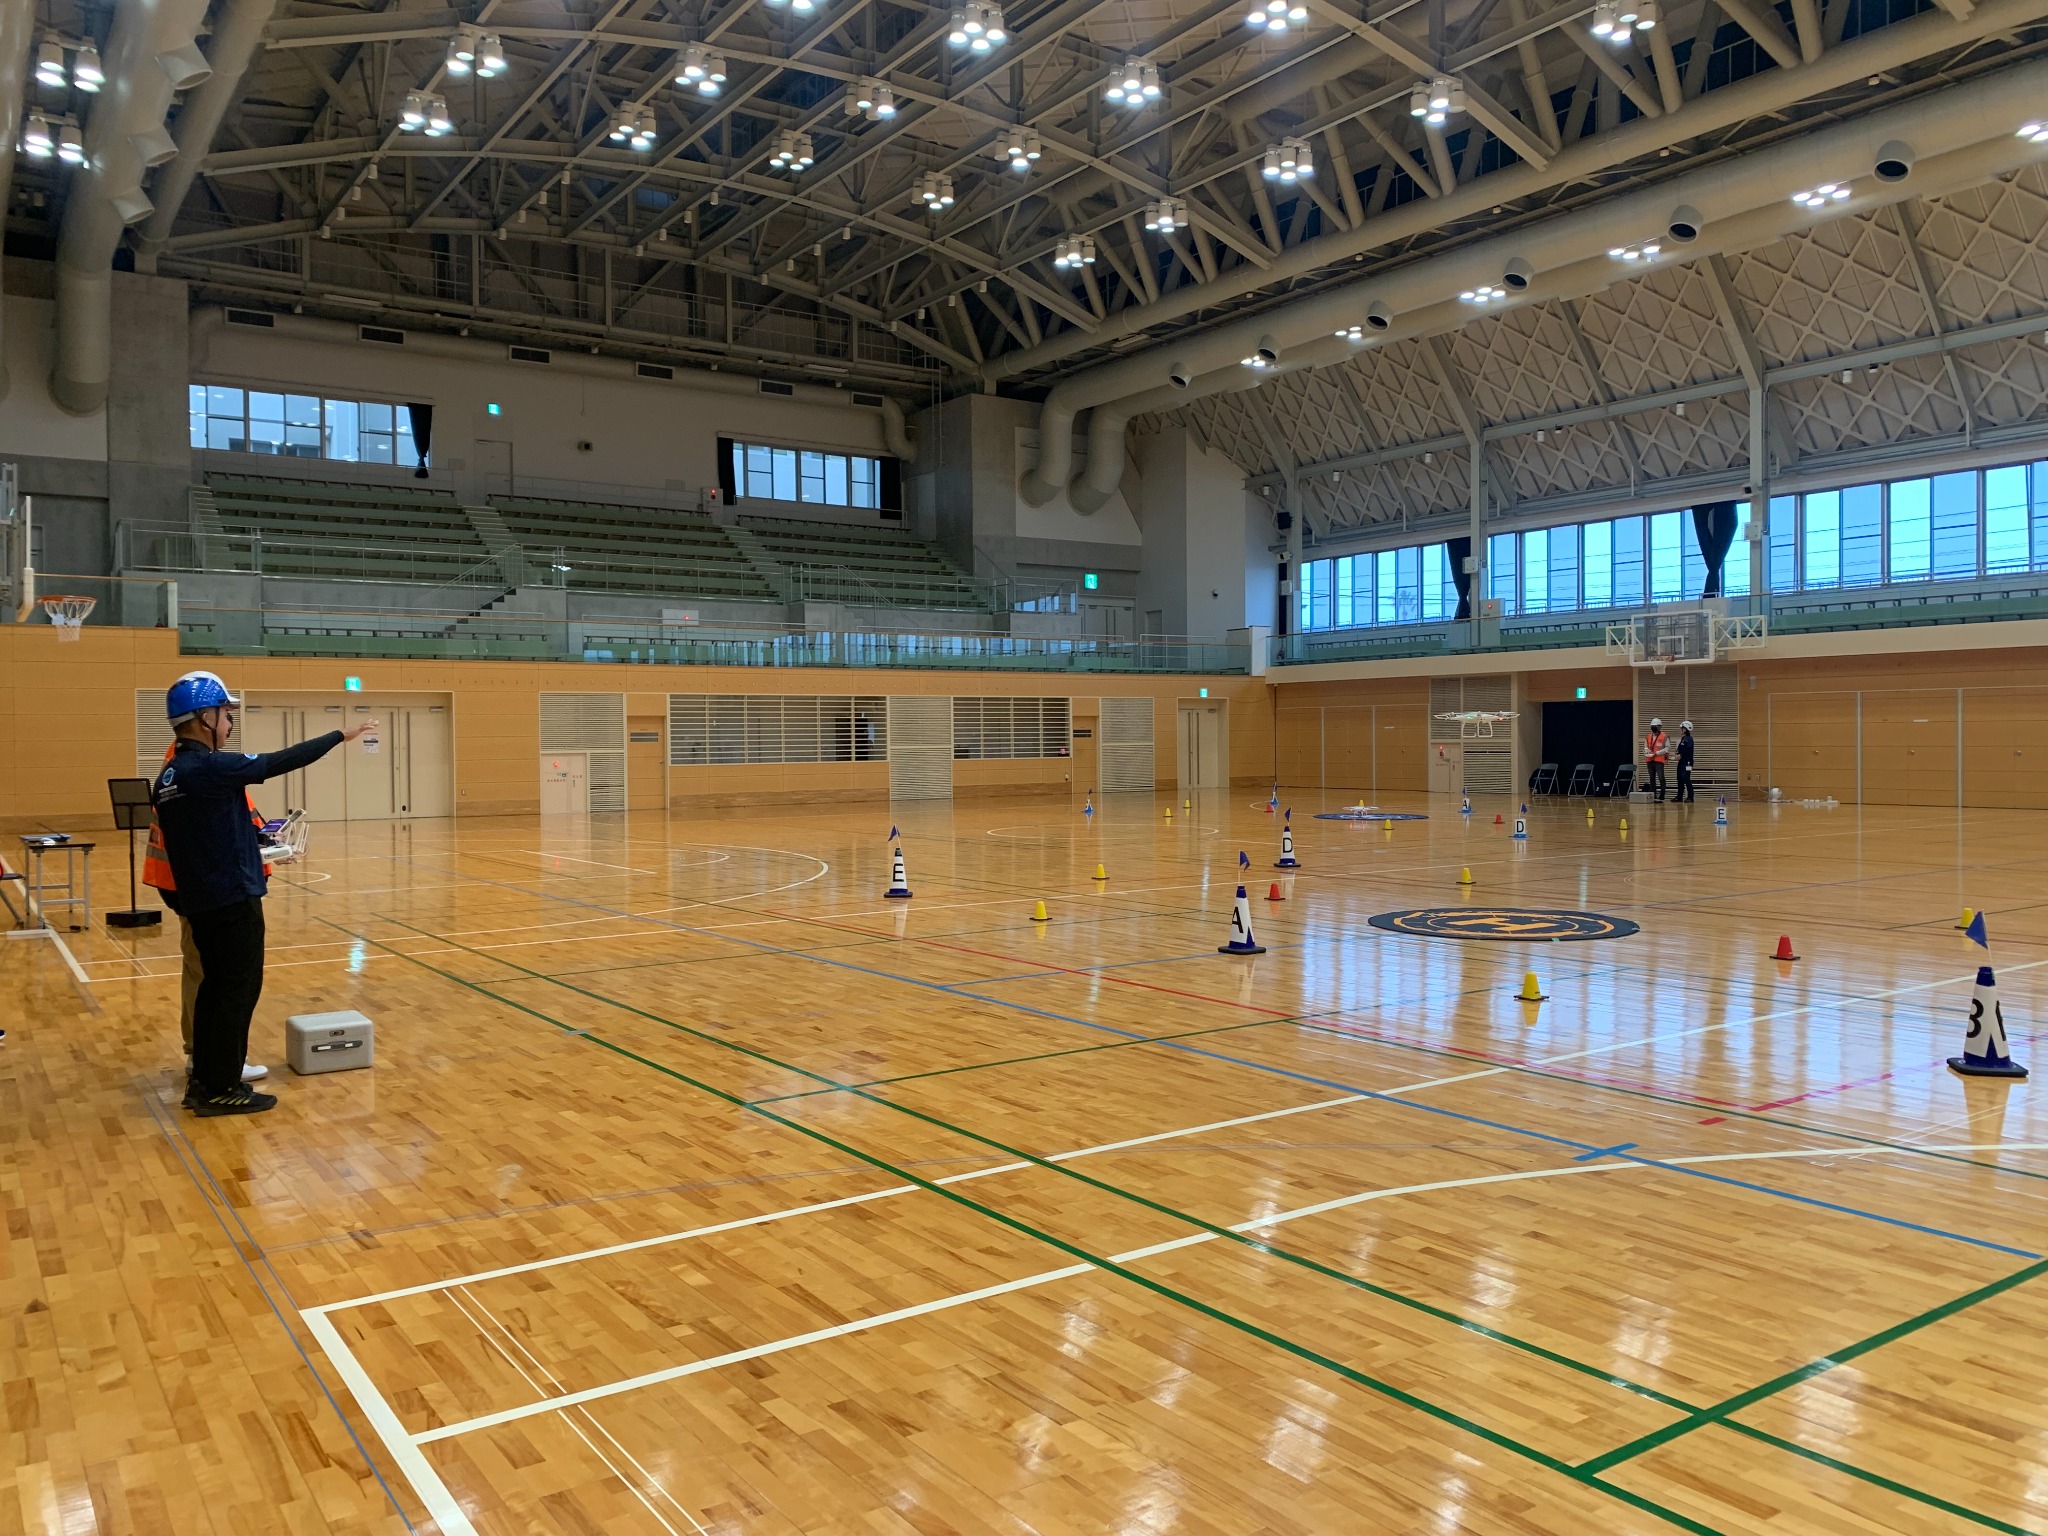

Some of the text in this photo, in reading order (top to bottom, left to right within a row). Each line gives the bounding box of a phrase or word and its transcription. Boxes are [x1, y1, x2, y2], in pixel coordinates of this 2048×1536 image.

[1462, 799, 1468, 809] A
[1718, 808, 1725, 820] E
[1516, 820, 1525, 833] D
[1282, 837, 1293, 853] D
[892, 863, 905, 882] E
[1231, 906, 1244, 934] A
